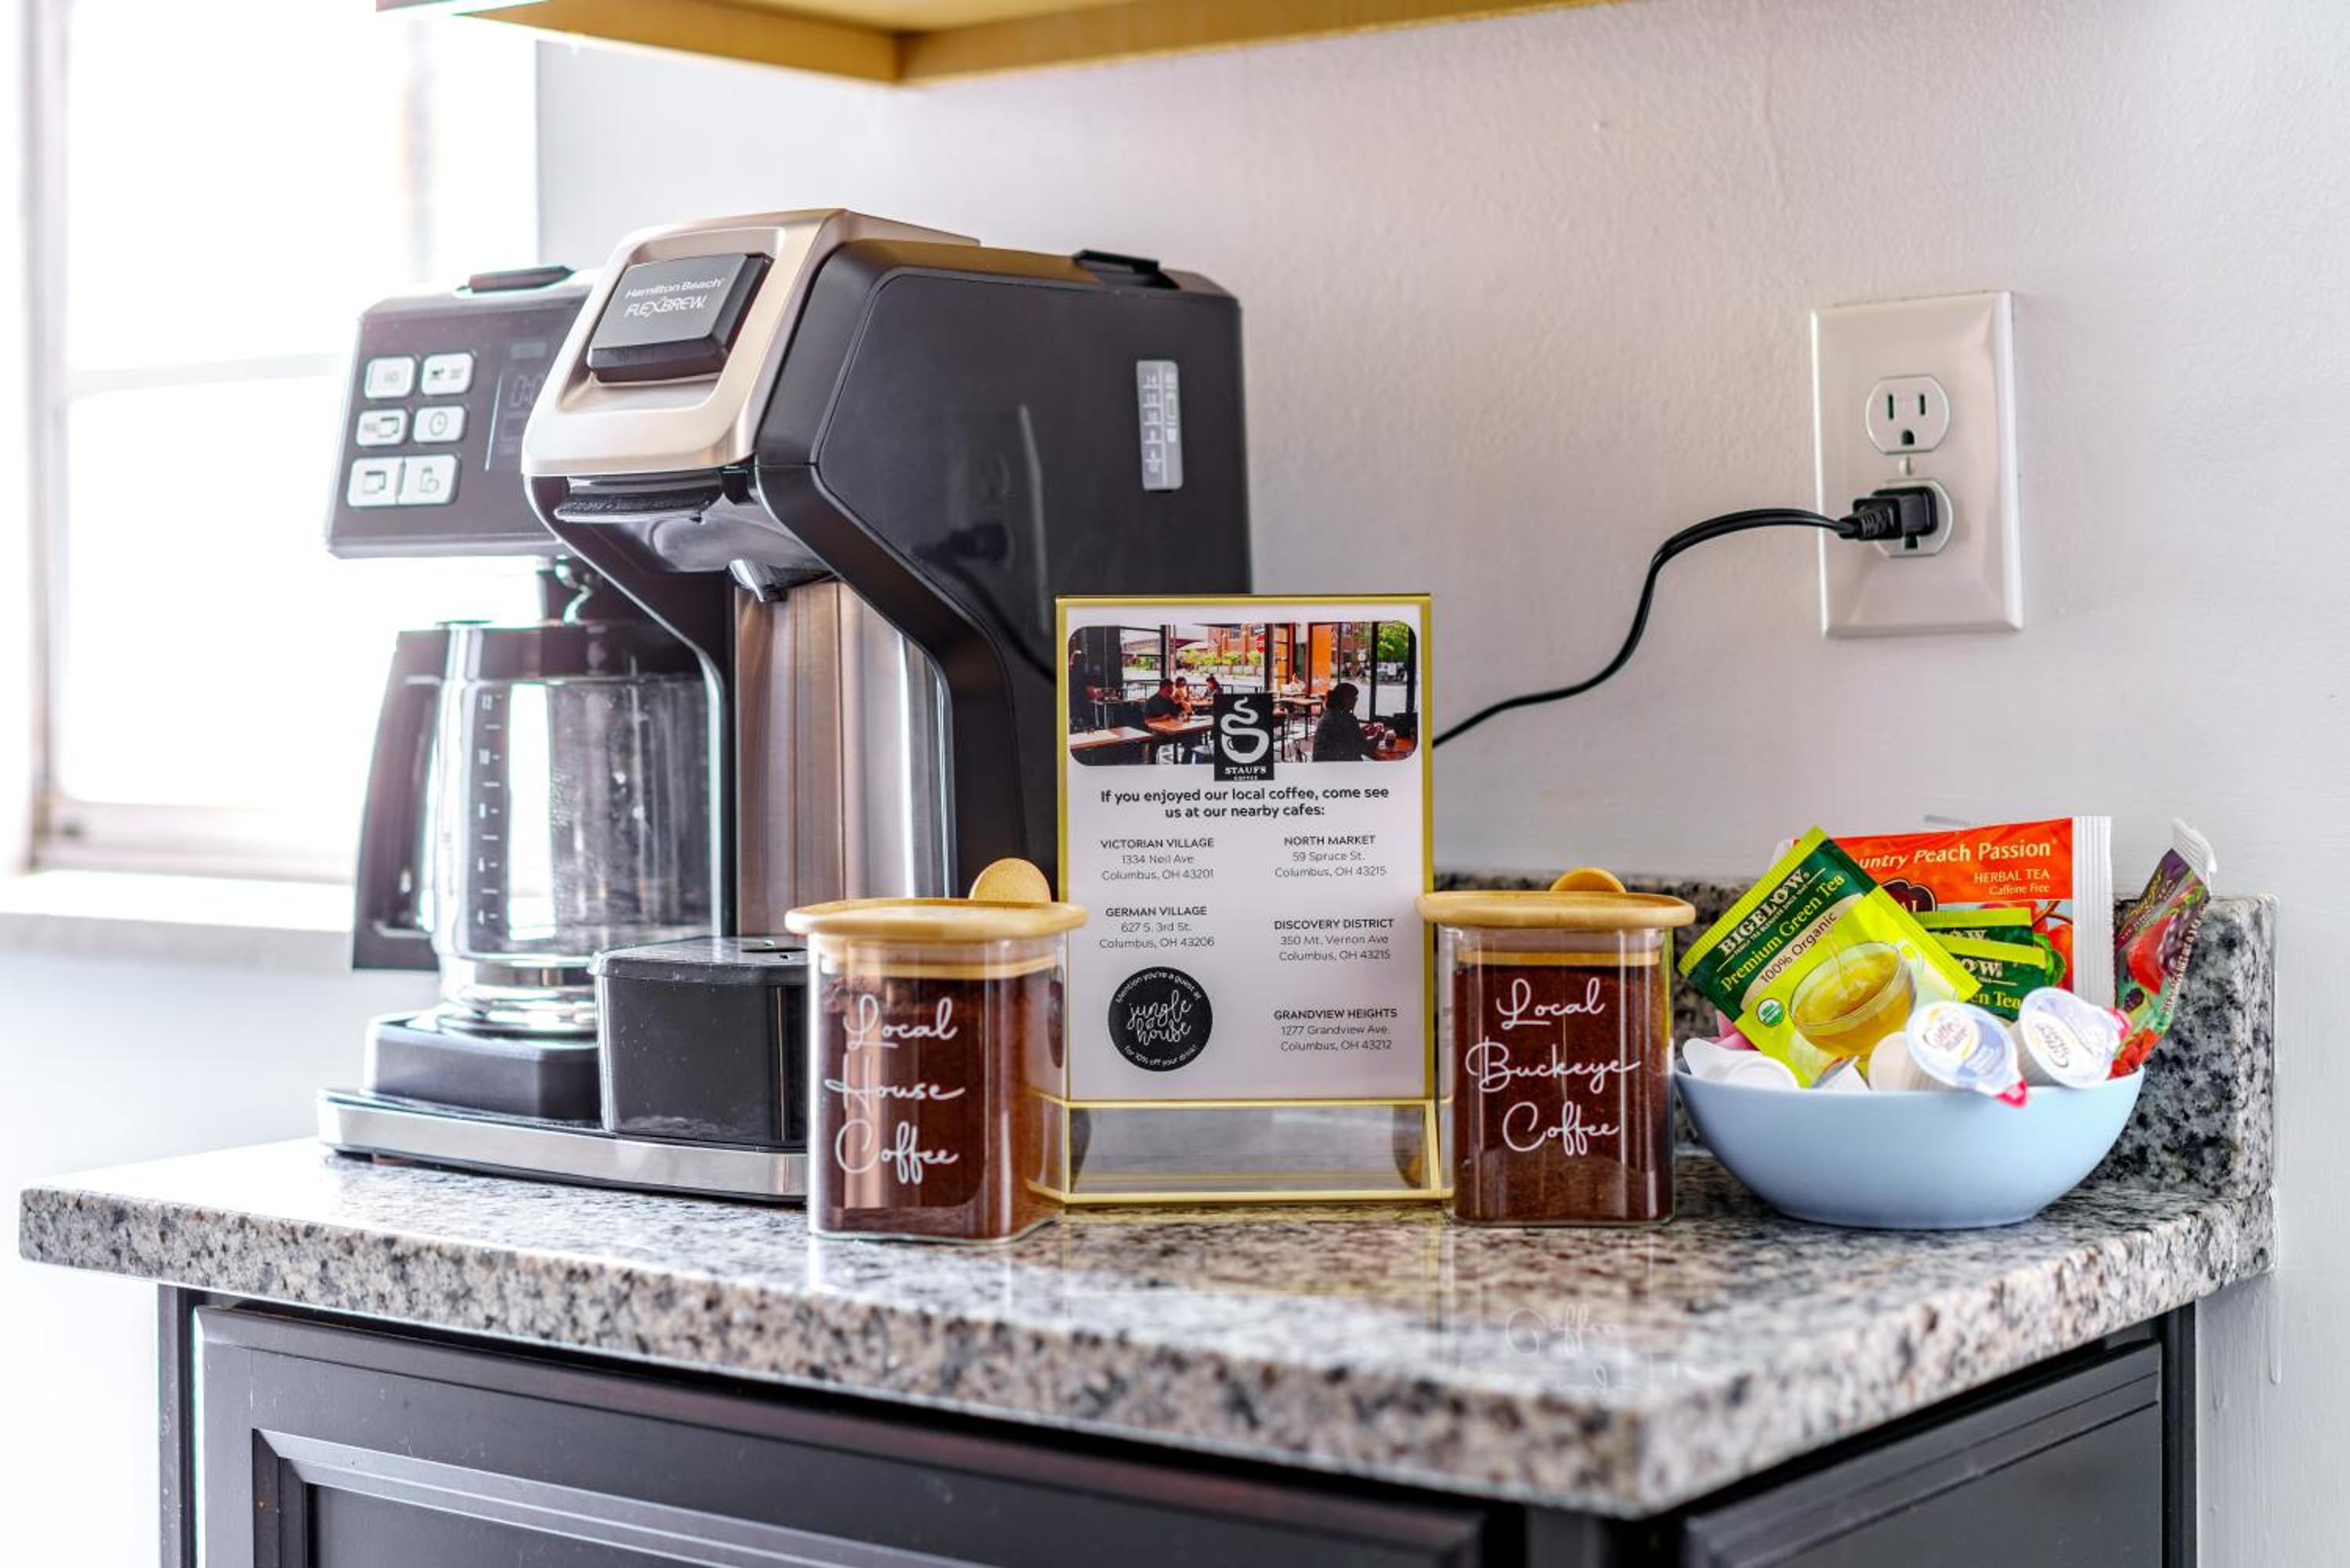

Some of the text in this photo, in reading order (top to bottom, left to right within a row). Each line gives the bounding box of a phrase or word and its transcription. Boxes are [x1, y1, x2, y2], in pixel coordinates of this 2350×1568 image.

[626, 278, 721, 298] Hamilton Beach
[1101, 787, 1389, 805] If you enjoyed our local coffee, come see
[1165, 804, 1325, 818] us at our nearby cafes:
[1101, 837, 1214, 849] VICTORIAN VILLAGE
[1284, 835, 1376, 846] NORTH MARKET
[1123, 854, 1195, 865] 1334 Neil Ave
[1292, 851, 1365, 862] 59 Spruce St.
[1856, 838, 2051, 869] untry Peach Passion
[1101, 869, 1213, 880] Columbus, OH 43201
[1274, 865, 1387, 877] Columbus, OH 43215
[1973, 869, 2050, 884] HERBAL TEA
[1988, 883, 2050, 896] Caffeine Free
[1105, 906, 1207, 917] GERMAN VILLAGE
[1717, 867, 1805, 957] BIGELOW
[1121, 922, 1141, 933] 627
[1156, 922, 1174, 932] 3rd
[1177, 923, 1192, 931] St.
[1274, 919, 1394, 930] DISCOVERY DISTRICT
[1280, 934, 1389, 945] 350 Mt. Vernon Ave
[1720, 935, 1784, 992] Premium
[1779, 896, 1823, 937] Green
[1817, 874, 1846, 898] Tea
[1099, 937, 1214, 948] Columbus, OH 43206
[1760, 954, 1793, 984] 100%
[1791, 912, 1838, 954] Organic
[1279, 949, 1390, 961] Columbus, OH 43215
[1495, 977, 1605, 1030] Local
[1993, 991, 2020, 1010] Tea
[1127, 989, 1192, 1030] jungle
[1274, 1008, 1398, 1020] GRANDVIEW HEIGHTS
[843, 993, 958, 1051] Local
[1137, 1017, 1191, 1046] house
[1281, 1025, 1304, 1035] 1277
[1307, 1025, 1365, 1035] Grandview
[1281, 1039, 1392, 1051] Columbus, OH 43212
[1465, 1035, 1641, 1094] Buckeye
[824, 1053, 966, 1115] House
[1502, 1100, 1620, 1156] Coffee
[835, 1118, 960, 1184] Coffee
